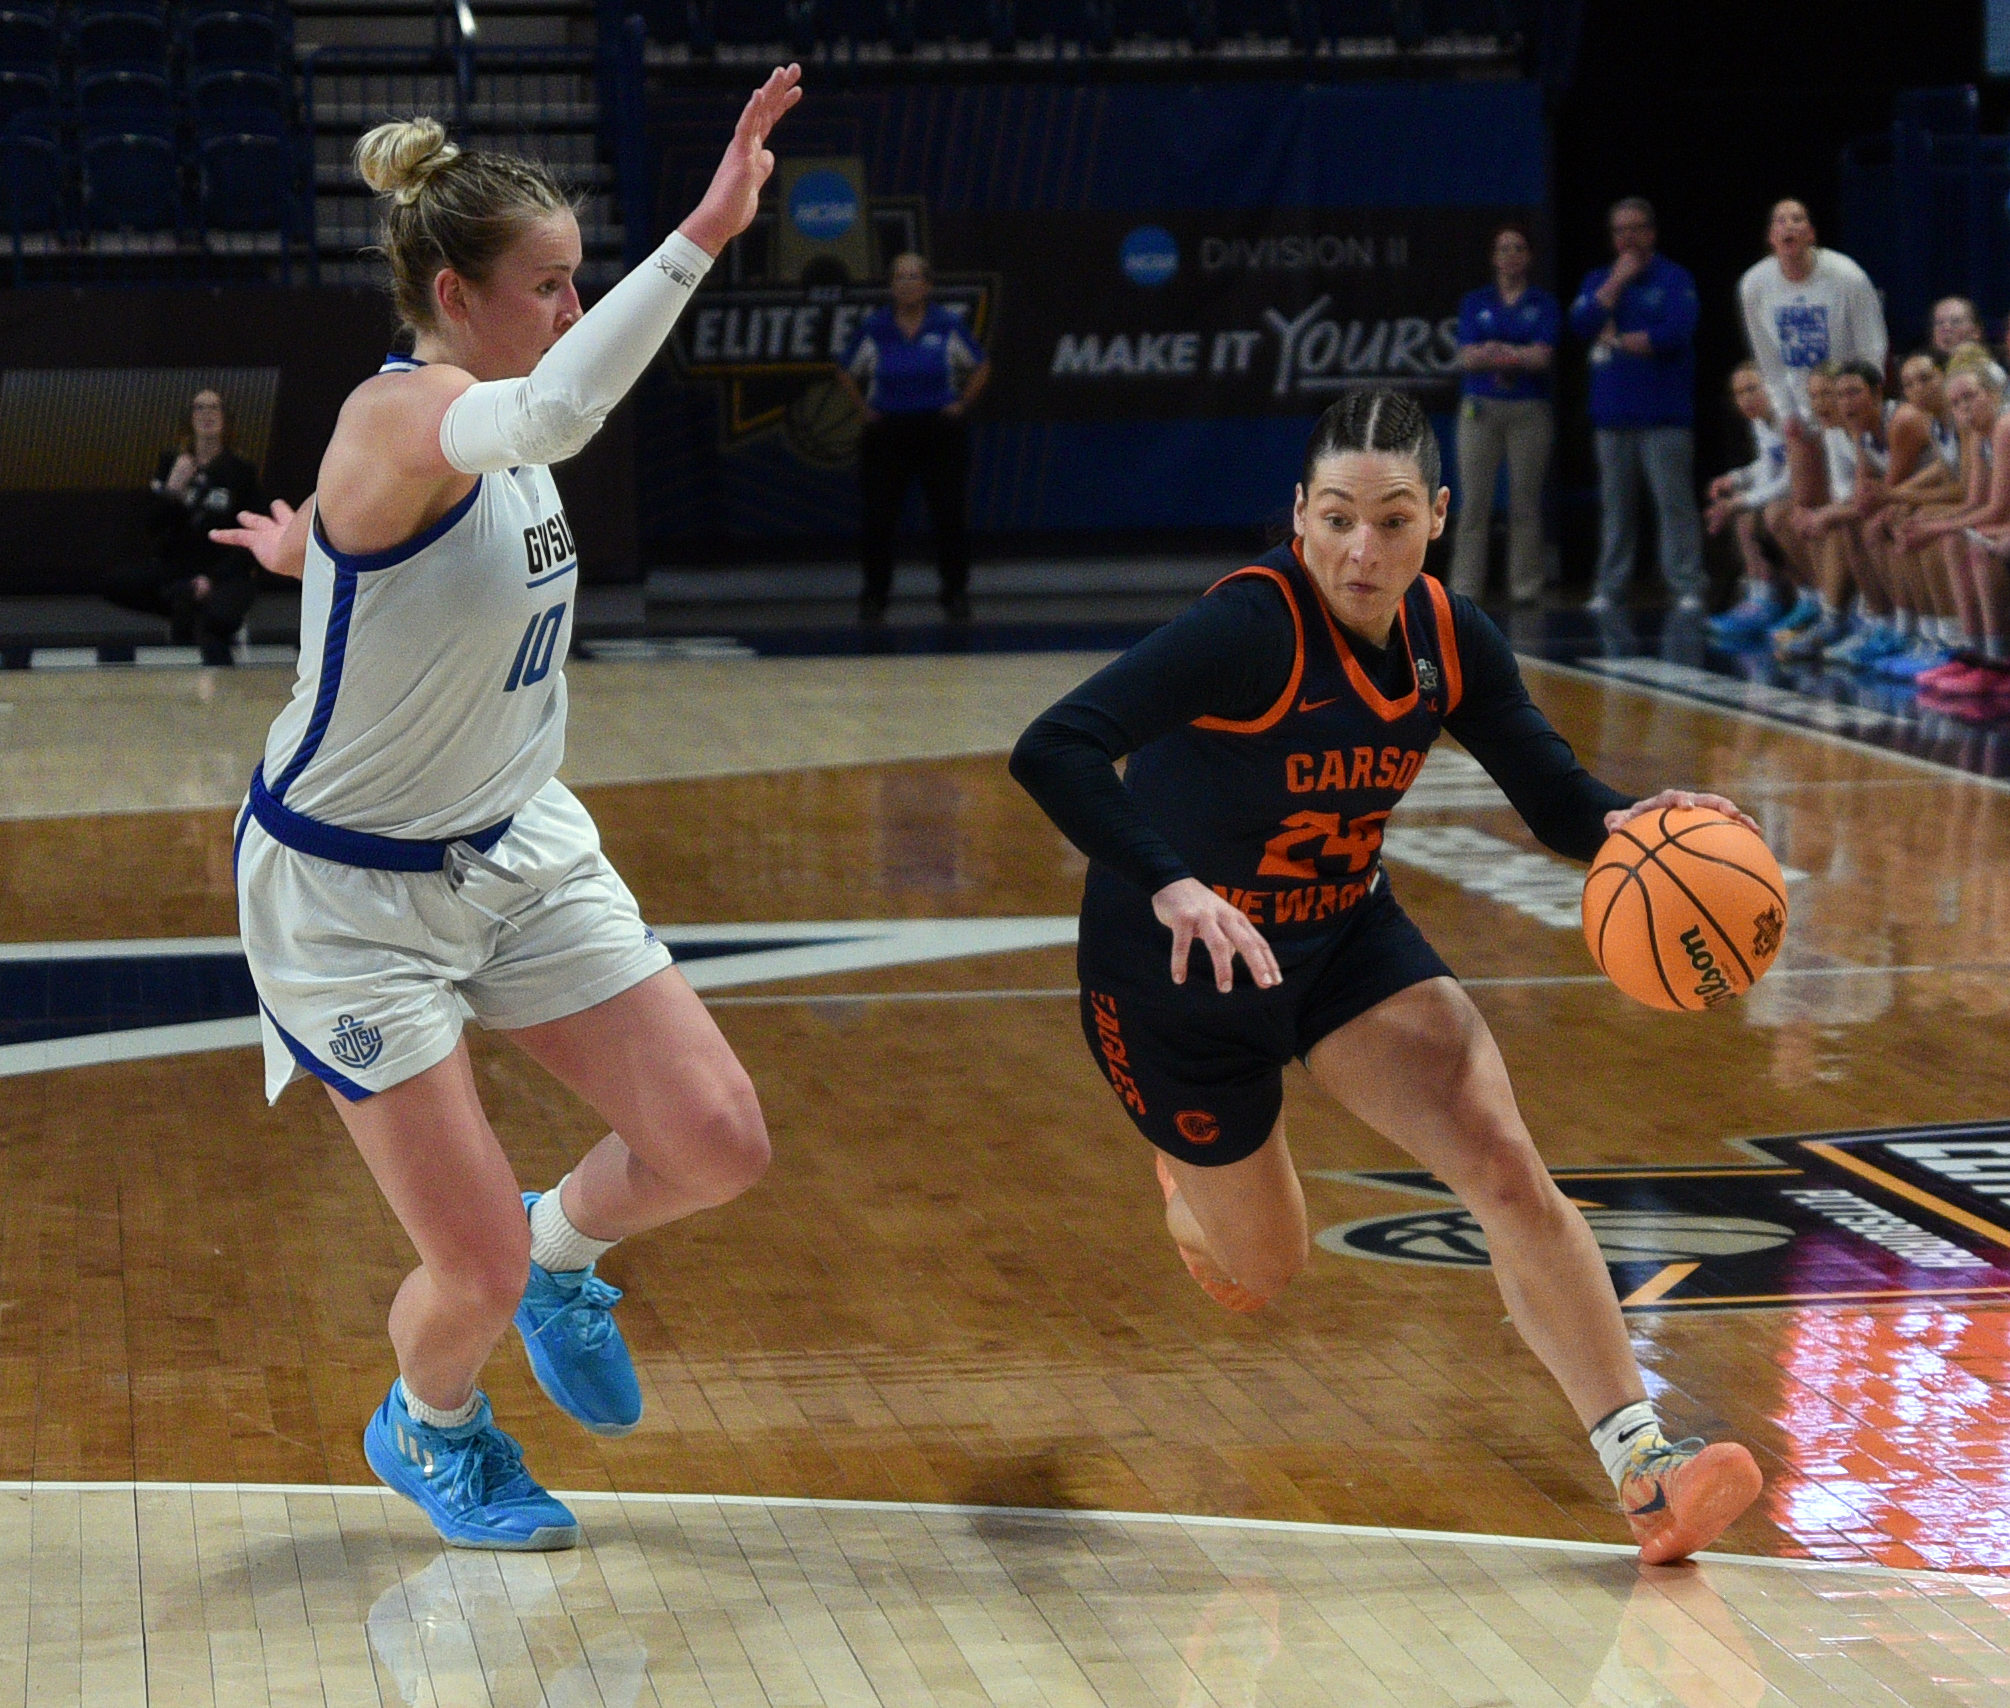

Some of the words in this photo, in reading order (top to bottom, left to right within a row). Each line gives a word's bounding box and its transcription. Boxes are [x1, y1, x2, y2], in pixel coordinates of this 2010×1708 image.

[1201, 235, 1375, 270] DIVISION
[696, 305, 822, 359] ELITE
[1052, 331, 1200, 376] MAKE
[1209, 330, 1262, 374] IT
[1264, 294, 1460, 395] YOURS
[503, 601, 567, 693] 10
[1256, 809, 1393, 880] 24
[1779, 1188, 1995, 1269] PITTSBURGH
